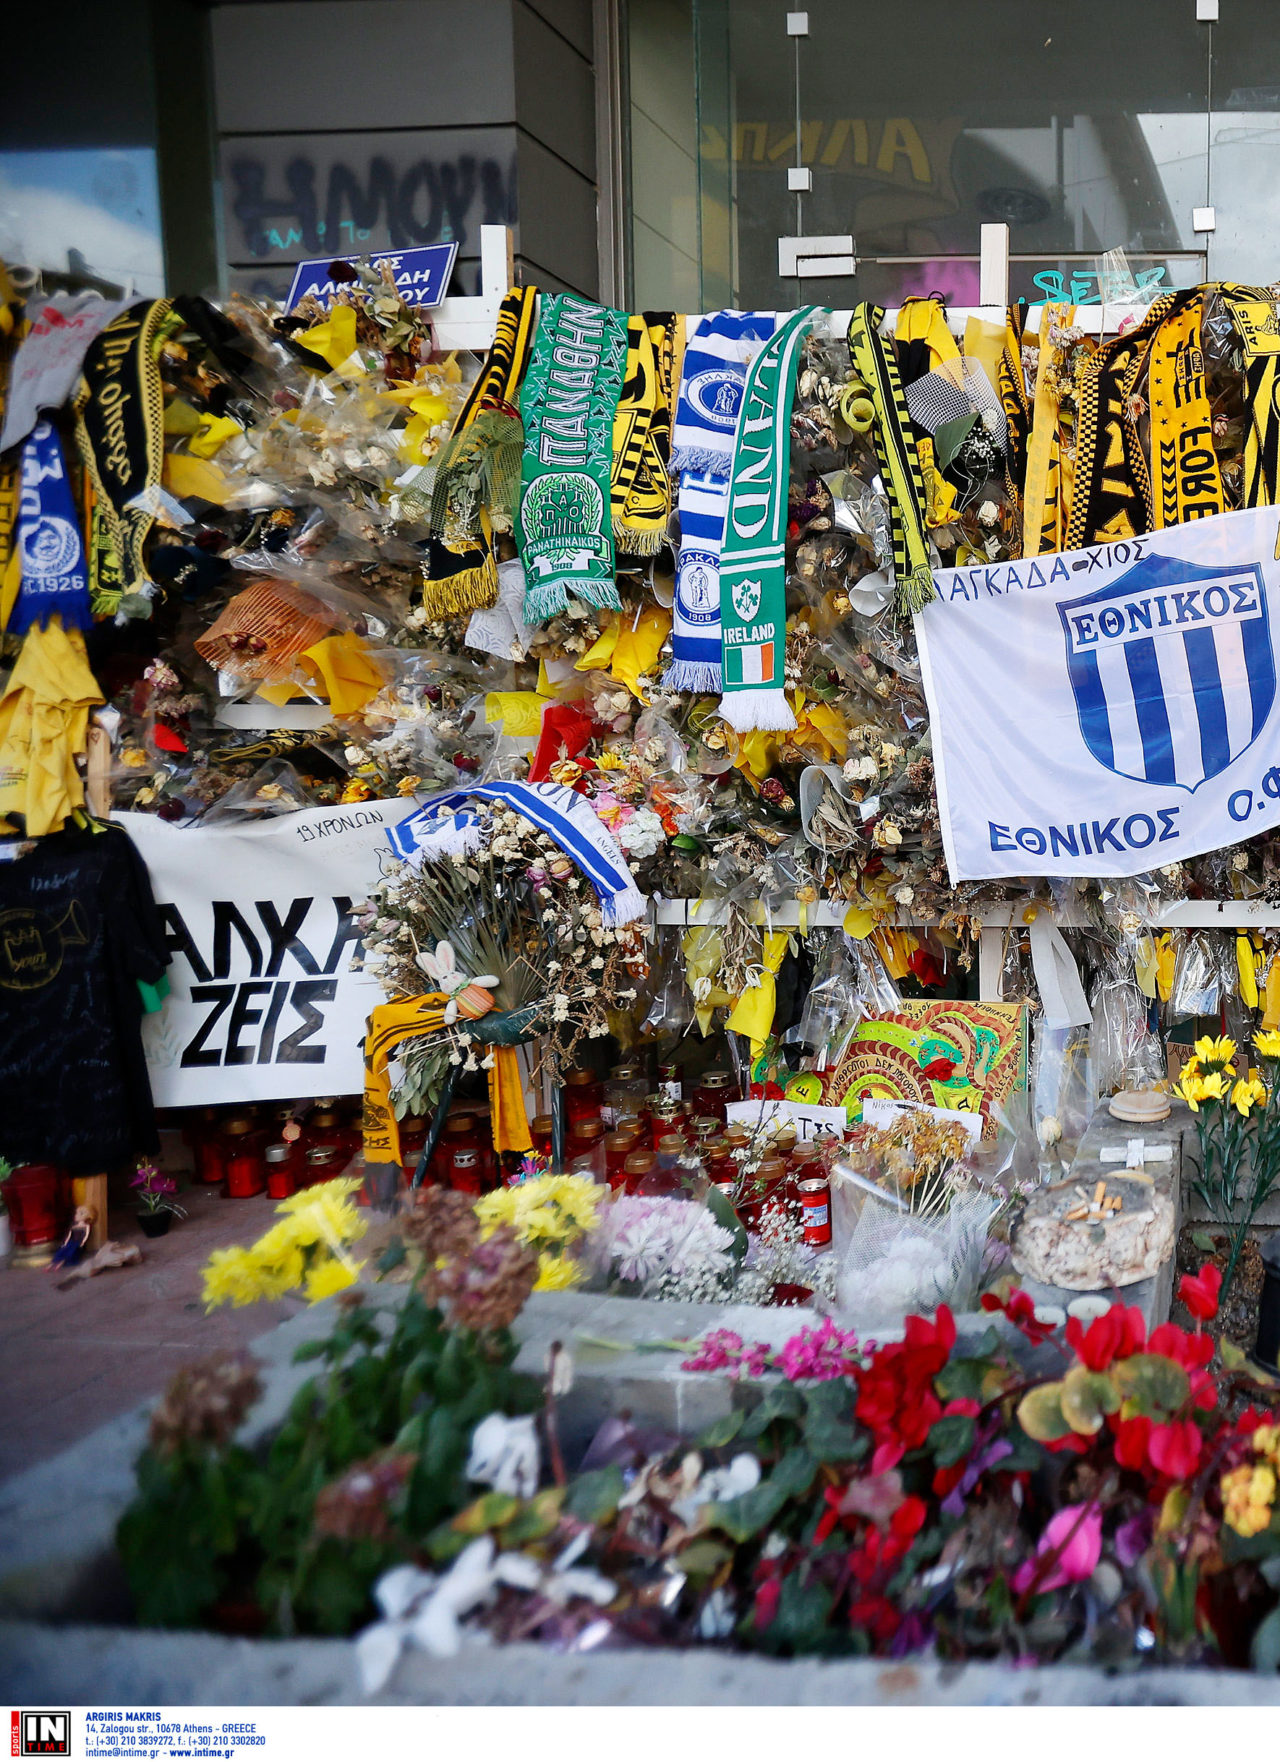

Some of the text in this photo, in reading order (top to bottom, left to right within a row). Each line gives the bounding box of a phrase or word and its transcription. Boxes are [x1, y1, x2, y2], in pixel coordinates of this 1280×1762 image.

[1239, 311, 1257, 346] ARIS
[527, 536, 601, 556] PANATHINAIKOS
[551, 562, 574, 571] 1908
[688, 612, 712, 622] 1908
[1071, 580, 1258, 647] ΕΘΝΙΚΟΣ
[724, 622, 776, 644] IRELAND
[297, 810, 383, 842] 19 ΧΡΟΝΩΝ
[988, 806, 1181, 857] ΕΘΝΙΚΟΣ
[595, 836, 622, 866] ANGELS
[180, 979, 338, 1068] ΖΕΙΣ
